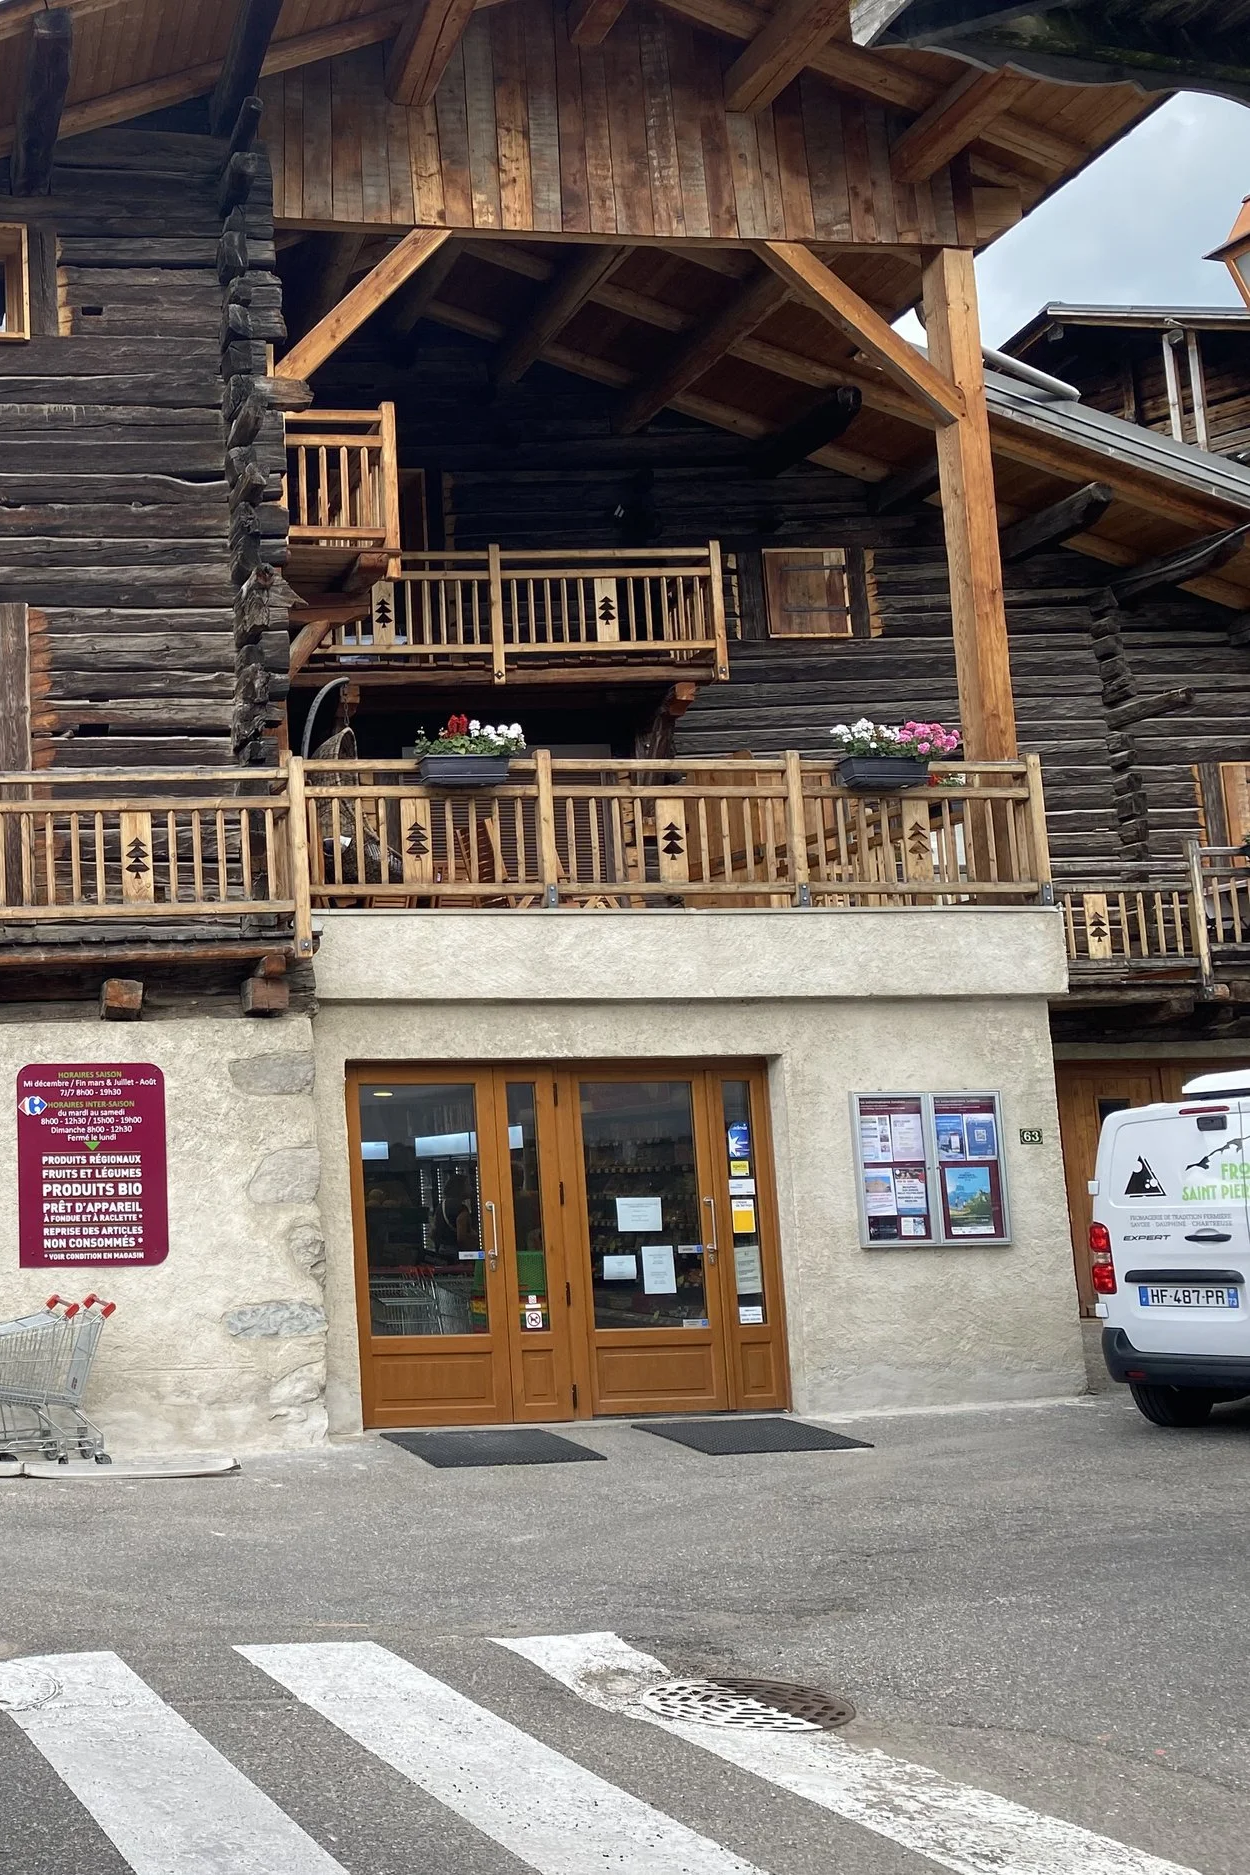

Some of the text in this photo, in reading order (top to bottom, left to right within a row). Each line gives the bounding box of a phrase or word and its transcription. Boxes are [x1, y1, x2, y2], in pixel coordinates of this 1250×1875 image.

[1023, 1131, 1039, 1142] 63
[42, 1154, 141, 1164] PRODUITS RÉGIONAUX
[43, 1167, 142, 1178] FRUITS ET LÉGUMES
[43, 1183, 142, 1196] PRODUITS BIO
[1182, 1185, 1217, 1200] SAINT
[43, 1200, 142, 1213] PRÊT D'APPAREIL
[44, 1214, 49, 1222] À
[93, 1213, 99, 1222] À
[43, 1227, 80, 1236] REPRISE
[44, 1235, 135, 1248] NON CONSOMMÉS
[1151, 1289, 1224, 1304] HF-487-PR
